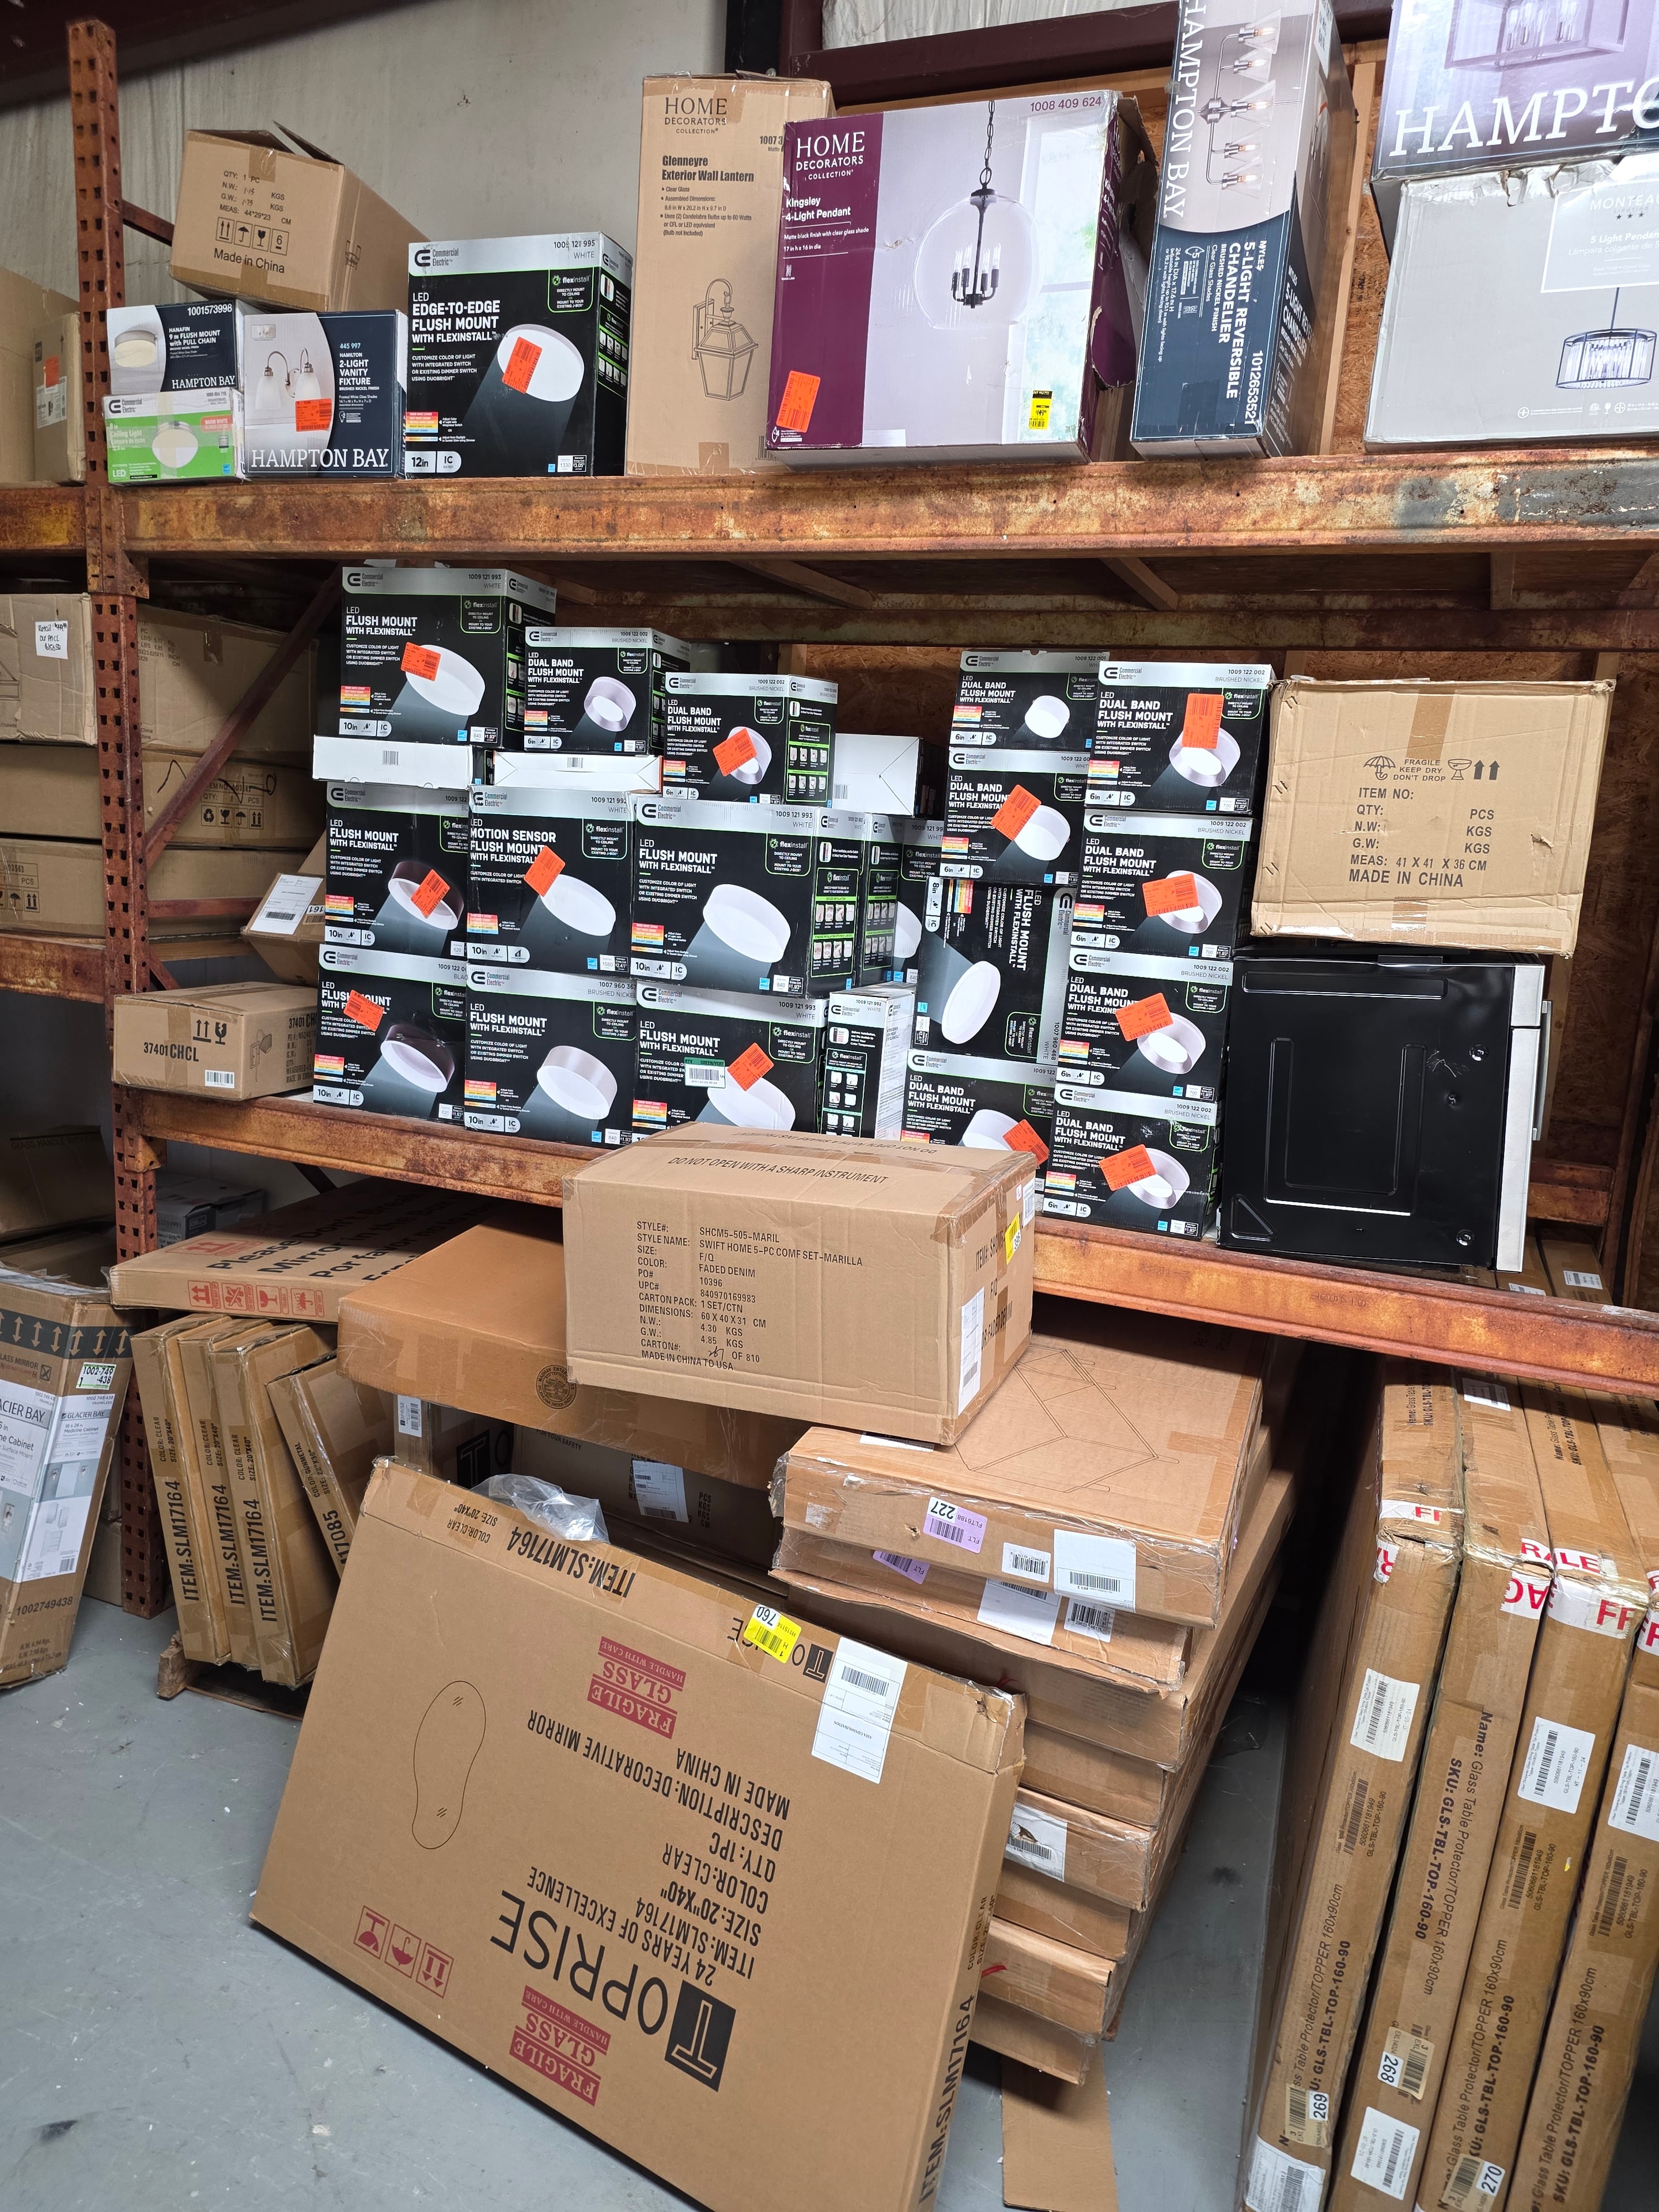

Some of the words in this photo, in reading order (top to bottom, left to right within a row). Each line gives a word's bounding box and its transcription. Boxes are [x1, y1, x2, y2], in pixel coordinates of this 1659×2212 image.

[665, 97, 728, 115] HOME
[1030, 100, 1055, 113] 1008
[1058, 98, 1080, 111] 409
[1081, 96, 1102, 109] 624
[664, 117, 726, 126] DECORATORS
[796, 131, 865, 158] HOME
[662, 156, 708, 167] Glenneyre
[224, 171, 238, 180] QTY:
[662, 170, 697, 181] Exterior
[698, 170, 718, 181] Wall
[720, 171, 754, 183] Lantern
[271, 192, 285, 200] KGS
[786, 196, 821, 208] Kingsley
[1590, 195, 1659, 210] MONTEA
[219, 204, 240, 215] MEAS:
[281, 217, 291, 225] CM
[785, 210, 815, 222] 4-Light
[816, 206, 851, 219] Pendant
[1599, 234, 1622, 245] Light
[214, 248, 242, 264] Made
[243, 254, 253, 266] in
[255, 256, 285, 274] China
[1257, 240, 1267, 271] MYLES
[1238, 241, 1256, 303] 5-LIGHT
[413, 293, 429, 302] LED
[1218, 242, 1241, 344] CHANDELIER
[187, 303, 233, 317] 1001573998
[412, 300, 501, 316] EDGE-TO-EDGE
[412, 317, 452, 331] FLUSH
[456, 316, 499, 330] MOUNT
[1226, 306, 1248, 399] REVERSIBLE
[339, 359, 369, 369] 2-LIGHT
[339, 368, 368, 377] VANITY
[172, 377, 217, 389] HAMPTON
[218, 376, 235, 386] BAY
[339, 377, 371, 386] FIXTURE
[1244, 350, 1263, 424] 1012653521
[251, 449, 348, 468] HAMPTON
[411, 457, 429, 468] 12in
[1100, 699, 1127, 709] DUAL
[1131, 700, 1160, 710] BAND
[1404, 758, 1441, 766] FRAGILE
[1422, 774, 1446, 782] DROP
[1090, 793, 1100, 801] 6in
[1358, 787, 1387, 799] ITEM
[1392, 788, 1414, 800] NO:
[470, 828, 510, 841] MOTION
[512, 830, 556, 843] SENSOR
[1350, 854, 1388, 866] MEAS:
[1396, 857, 1407, 868] 41
[1411, 857, 1421, 868] X
[1423, 857, 1433, 868] 41
[1441, 858, 1449, 869] X
[1453, 859, 1465, 869] 36
[1468, 859, 1487, 871] CM
[1349, 869, 1391, 884] MADE
[1396, 871, 1411, 885] IN
[1418, 872, 1464, 887] CHINA
[1022, 889, 1033, 929] FLUSH
[1017, 930, 1031, 971] MOUNT
[687, 1157, 711, 1166] NOT
[709, 1158, 738, 1169] OPEN
[737, 1162, 771, 1172] WITH
[769, 1164, 777, 1172] A
[777, 1166, 816, 1176] SHARP
[812, 1169, 888, 1184] INSTRUMENT
[637, 1221, 668, 1232] STYLE#:
[699, 1227, 779, 1243] SHCM5-505-MARIL
[207, 1239, 302, 1270] Please
[257, 1243, 349, 1273] Mirror
[699, 1240, 726, 1251] SWIFT
[727, 1242, 752, 1253] HOME
[754, 1245, 774, 1255] 5-PC
[776, 1248, 801, 1259] COMF
[802, 1251, 862, 1266] SET-MARILLA
[699, 1253, 714, 1262] F/Q
[699, 1264, 726, 1275] FADED
[728, 1267, 755, 1278] DENIM
[699, 1277, 722, 1287] 10396
[700, 1289, 756, 1303] 840970169983
[639, 1304, 694, 1318] DIMENSIONS:
[641, 1339, 681, 1351] CARTON#:
[83, 1367, 113, 1376] 1002-749
[67, 1411, 92, 1419] GLACIER
[9, 1436, 34, 1451] Cabinet
[232, 1434, 241, 1456] CLEAR
[562, 1438, 581, 1450] SAFETY
[930, 1501, 956, 1519] 227
[957, 1514, 983, 1528] FLT6188
[165, 1480, 200, 1601] ITEM:SLM17164
[243, 1499, 278, 1622] ITEM:SLM17164
[16, 1596, 73, 1616] 1002749438
[757, 1607, 776, 1626] 760
[603, 1661, 672, 1704] GLASS
[592, 1684, 673, 1733] FRAGILE
[527, 1709, 581, 1752] MIRROR
[1475, 1711, 1493, 1756] Name:
[582, 1737, 673, 1798] DECORATIVE
[1445, 1758, 1463, 1794] SKU:
[1466, 1761, 1483, 1794] Glass
[1525, 1850, 1544, 1899] 5060661181949
[527, 1866, 617, 1932] EXCELLENCE
[618, 1918, 639, 1944] OF
[635, 1897, 755, 1979] ITEM:SLM17164
[642, 1930, 691, 1975] YEARS
[695, 1958, 717, 1986] 24
[1483, 1939, 1507, 2005] 160x90cm
[1313, 1940, 1351, 2075] GLS-TBL-TOP-160-90
[1380, 2054, 1399, 2083] 268
[1478, 1995, 1515, 2135] GLS-TBL-TOP-160-90
[1313, 2094, 1328, 2119] 269
[1481, 2165, 1503, 2194] 270
